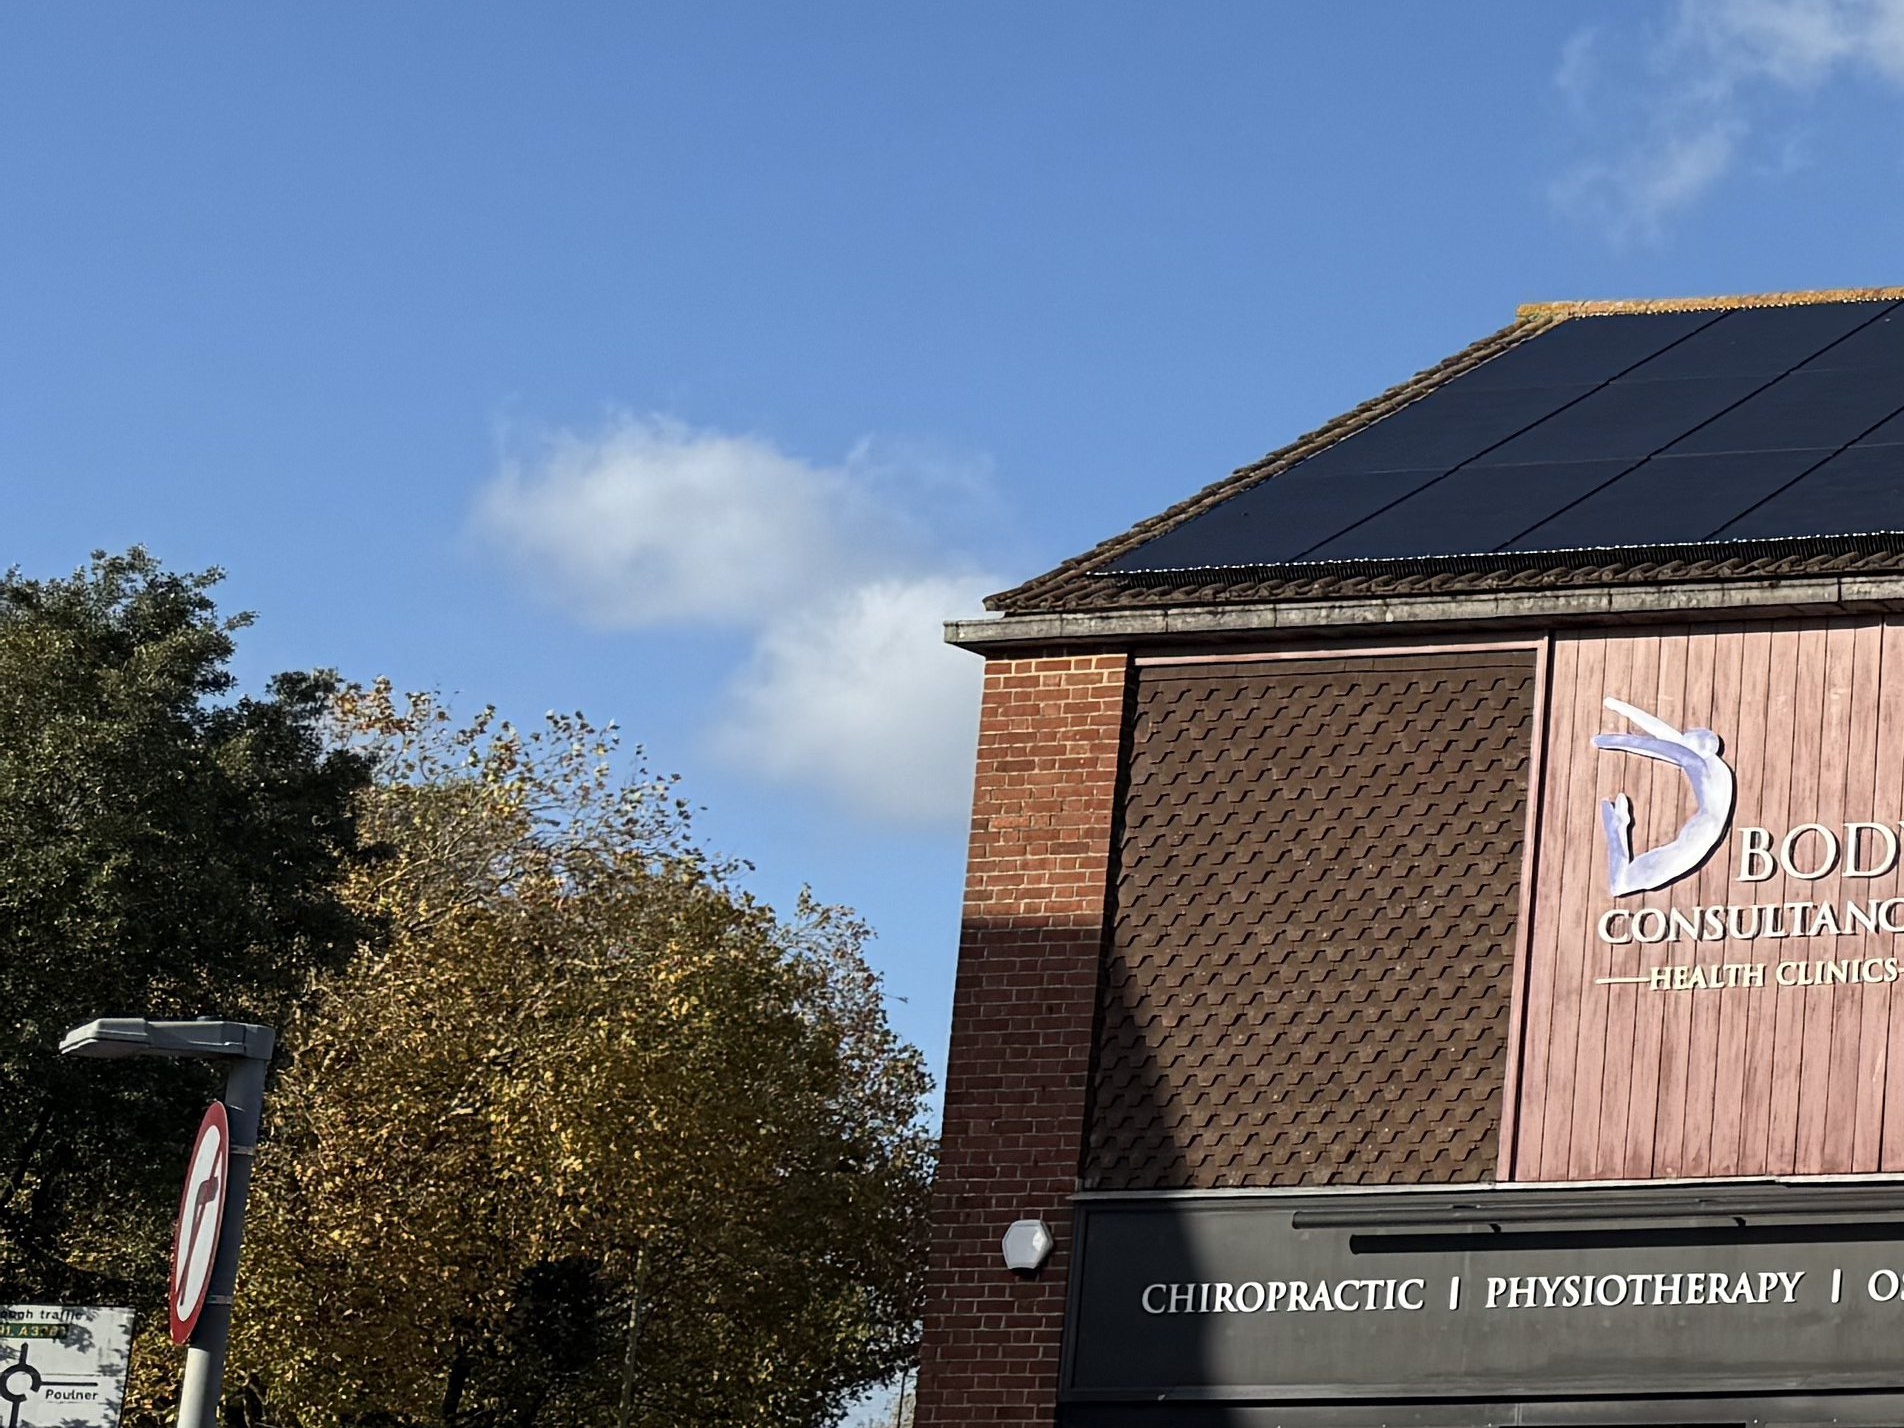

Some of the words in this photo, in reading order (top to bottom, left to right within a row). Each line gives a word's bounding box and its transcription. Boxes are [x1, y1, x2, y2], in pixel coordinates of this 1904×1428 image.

[1650, 962, 1765, 991] HEALTH
[1775, 957, 1899, 988] CLINICS
[1141, 1277, 1424, 1314] CHIROPRACTIC
[1485, 1270, 1805, 1310] PHYSIOTHERAPY
[45, 1389, 99, 1401] Poulner
